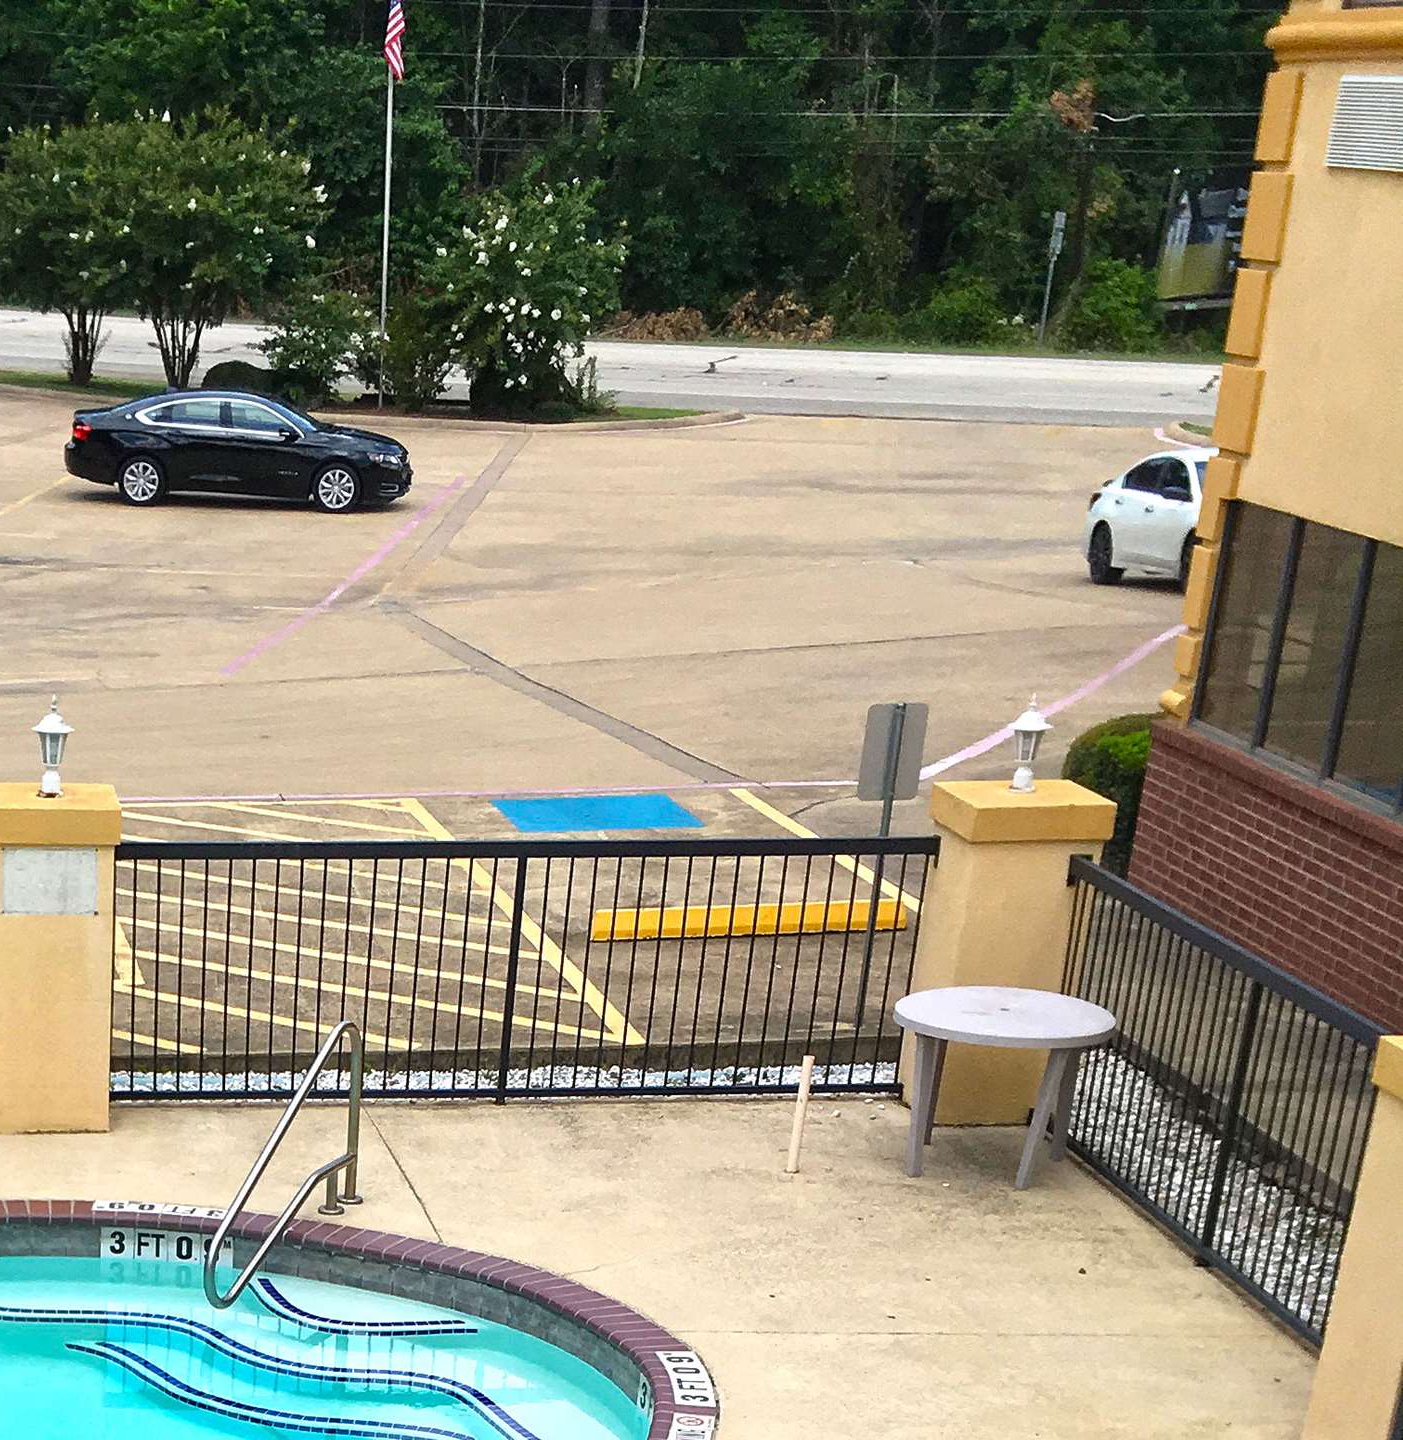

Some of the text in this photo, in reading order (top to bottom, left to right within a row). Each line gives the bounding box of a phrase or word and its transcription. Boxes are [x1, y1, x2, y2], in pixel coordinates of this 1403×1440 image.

[109, 1231, 126, 1255] 3
[137, 1232, 165, 1258] FT
[676, 1378, 708, 1390] FT
[681, 1394, 709, 1402] 3
